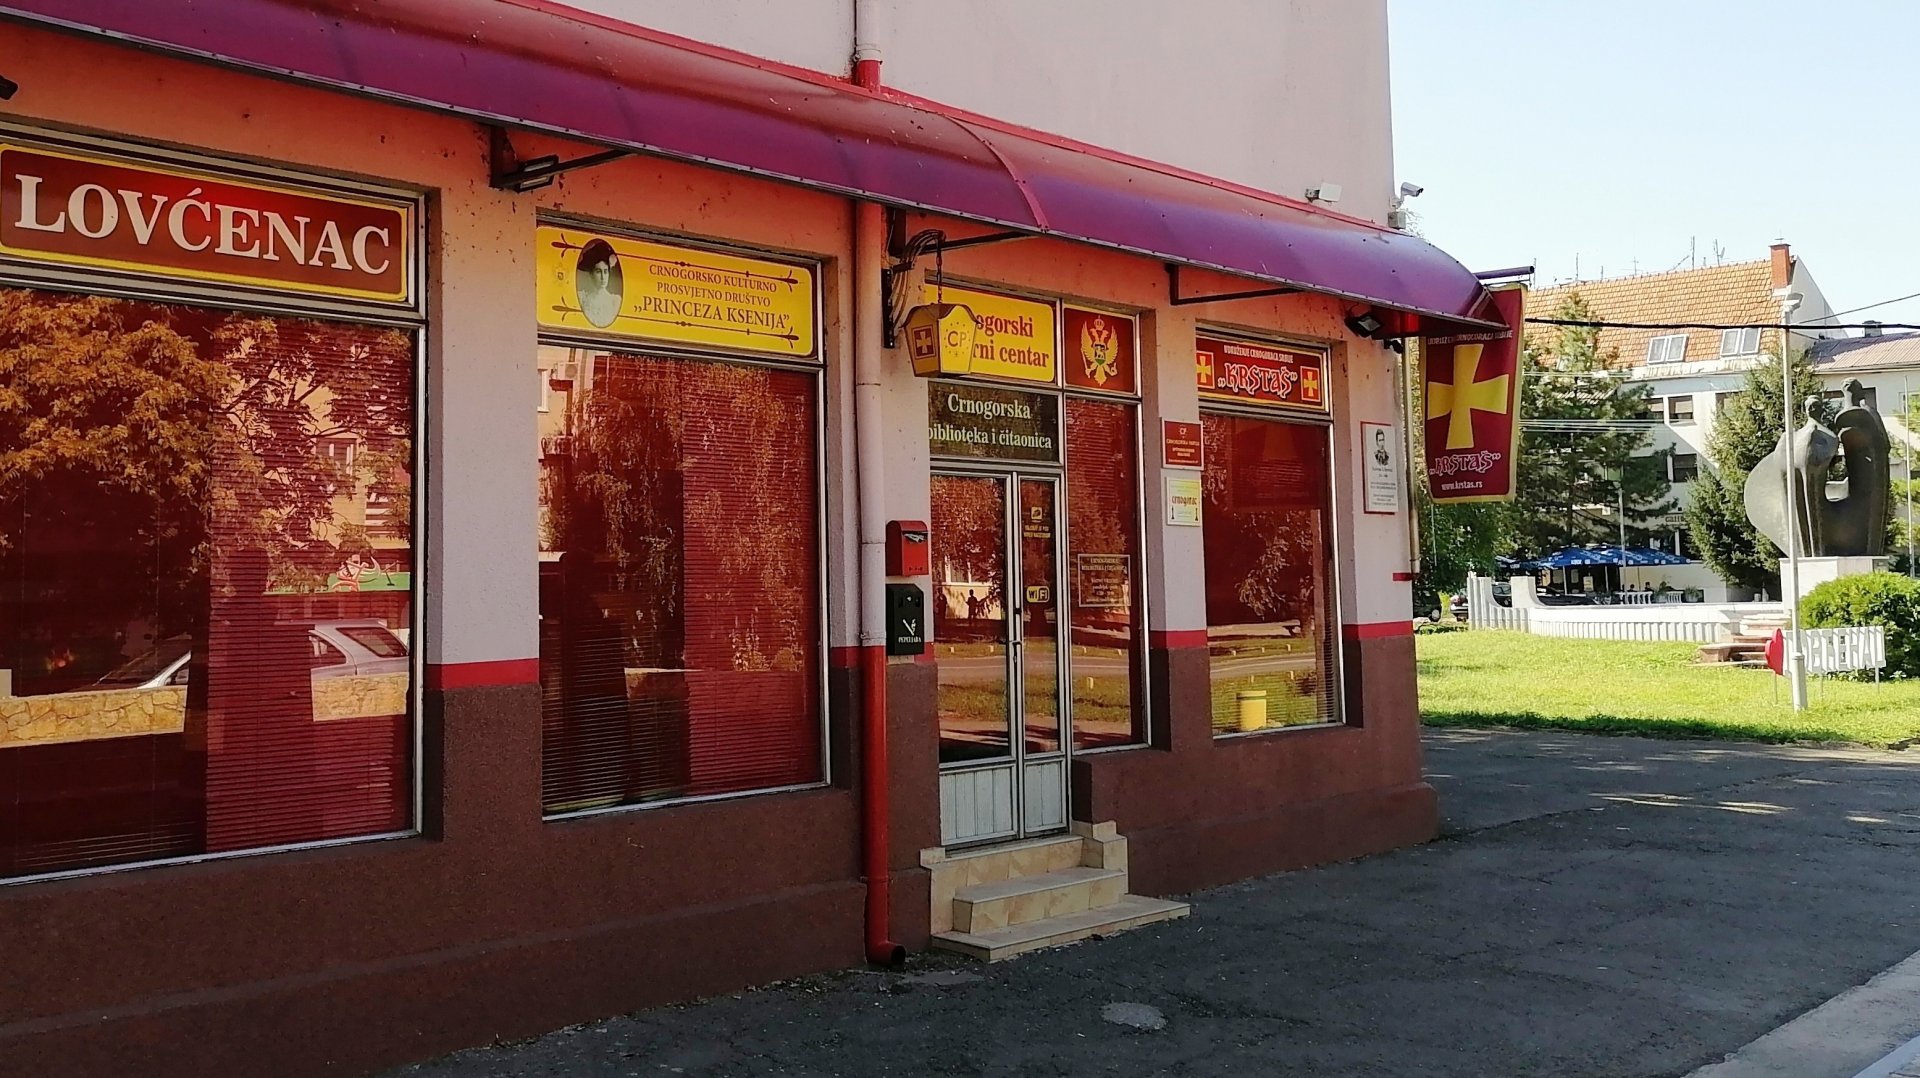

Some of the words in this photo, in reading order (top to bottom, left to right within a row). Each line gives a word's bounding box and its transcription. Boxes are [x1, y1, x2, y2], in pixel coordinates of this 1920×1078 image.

[14, 173, 390, 275] LOVĆENAC
[649, 264, 722, 285] CRNOGORSKO
[723, 276, 777, 293] KULTURNO
[656, 281, 722, 302] PROSVJETNO
[725, 290, 771, 307] DRUŠTVO
[976, 314, 1034, 338] ogorski
[947, 330, 967, 348] CP
[999, 345, 1049, 368] centar
[947, 393, 1031, 420] Crnogorska
[991, 428, 997, 444] i
[999, 428, 1052, 449] čitaonica
